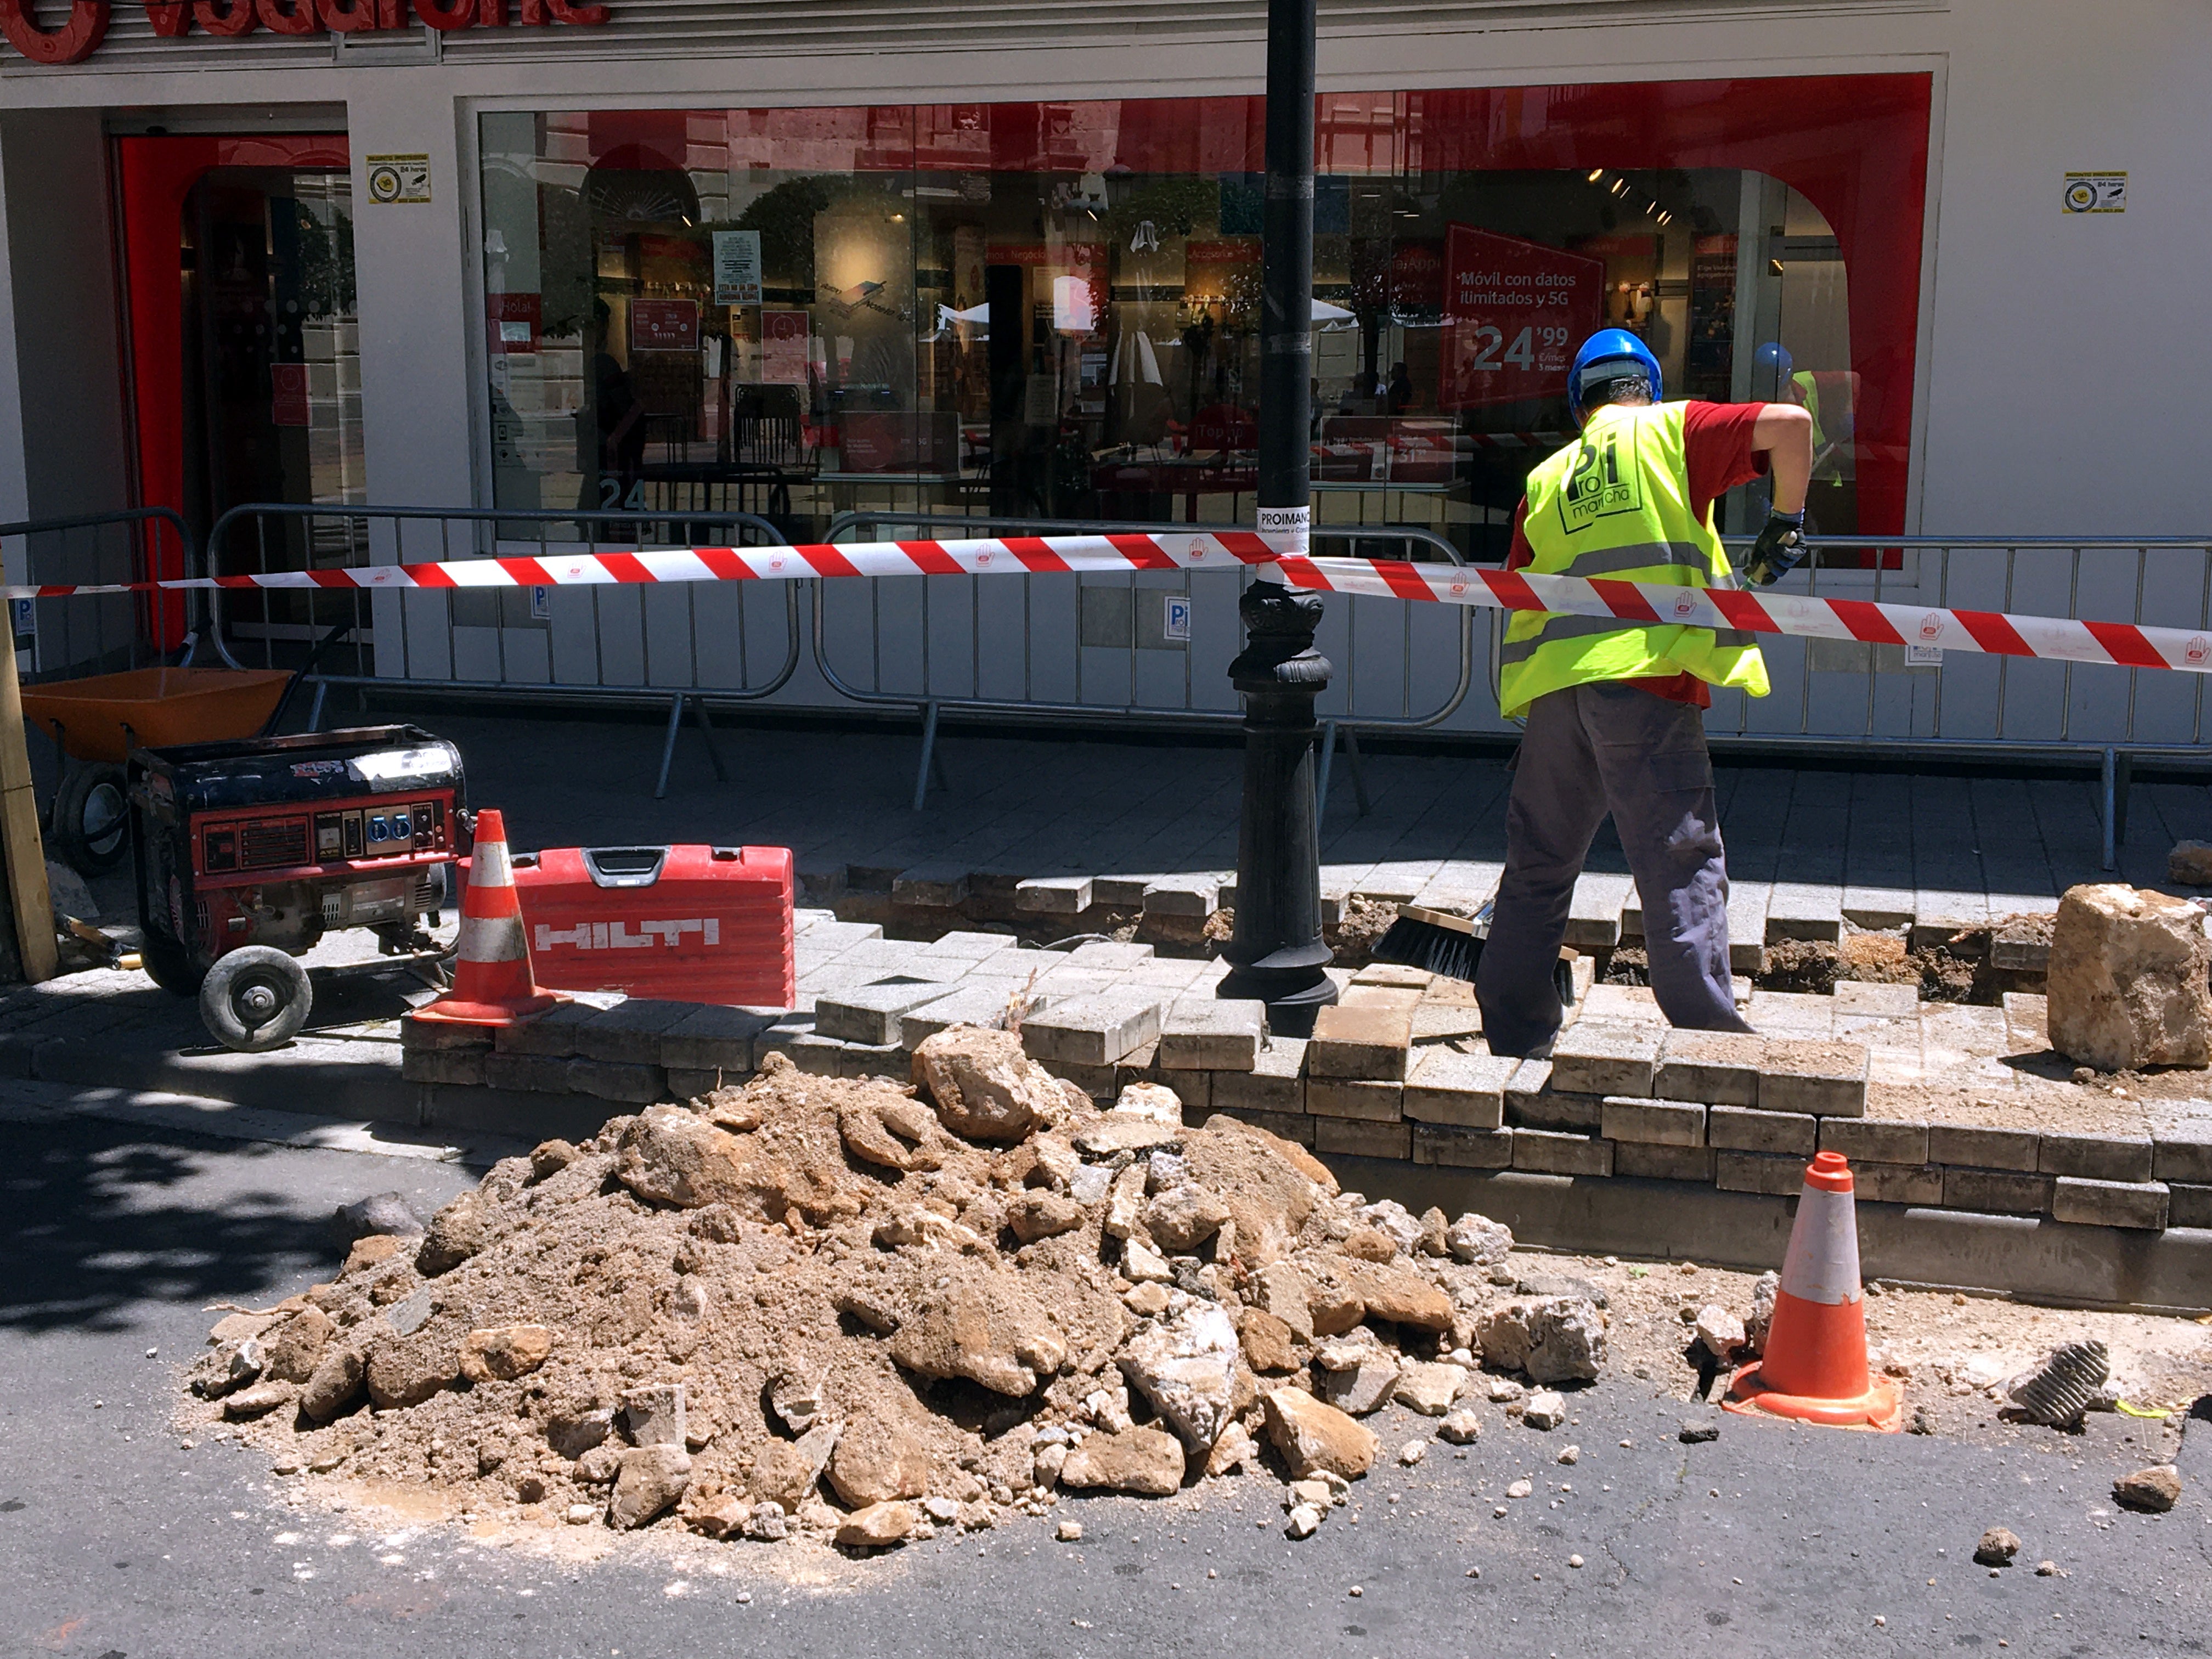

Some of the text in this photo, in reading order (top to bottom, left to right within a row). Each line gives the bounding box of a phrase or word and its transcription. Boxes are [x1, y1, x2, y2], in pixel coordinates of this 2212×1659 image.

[1461, 270, 1576, 286] Móvil con datos
[1460, 291, 1568, 308] ilimitados y 5G
[1195, 424, 1223, 439] Top
[534, 918, 720, 951] HILTI
